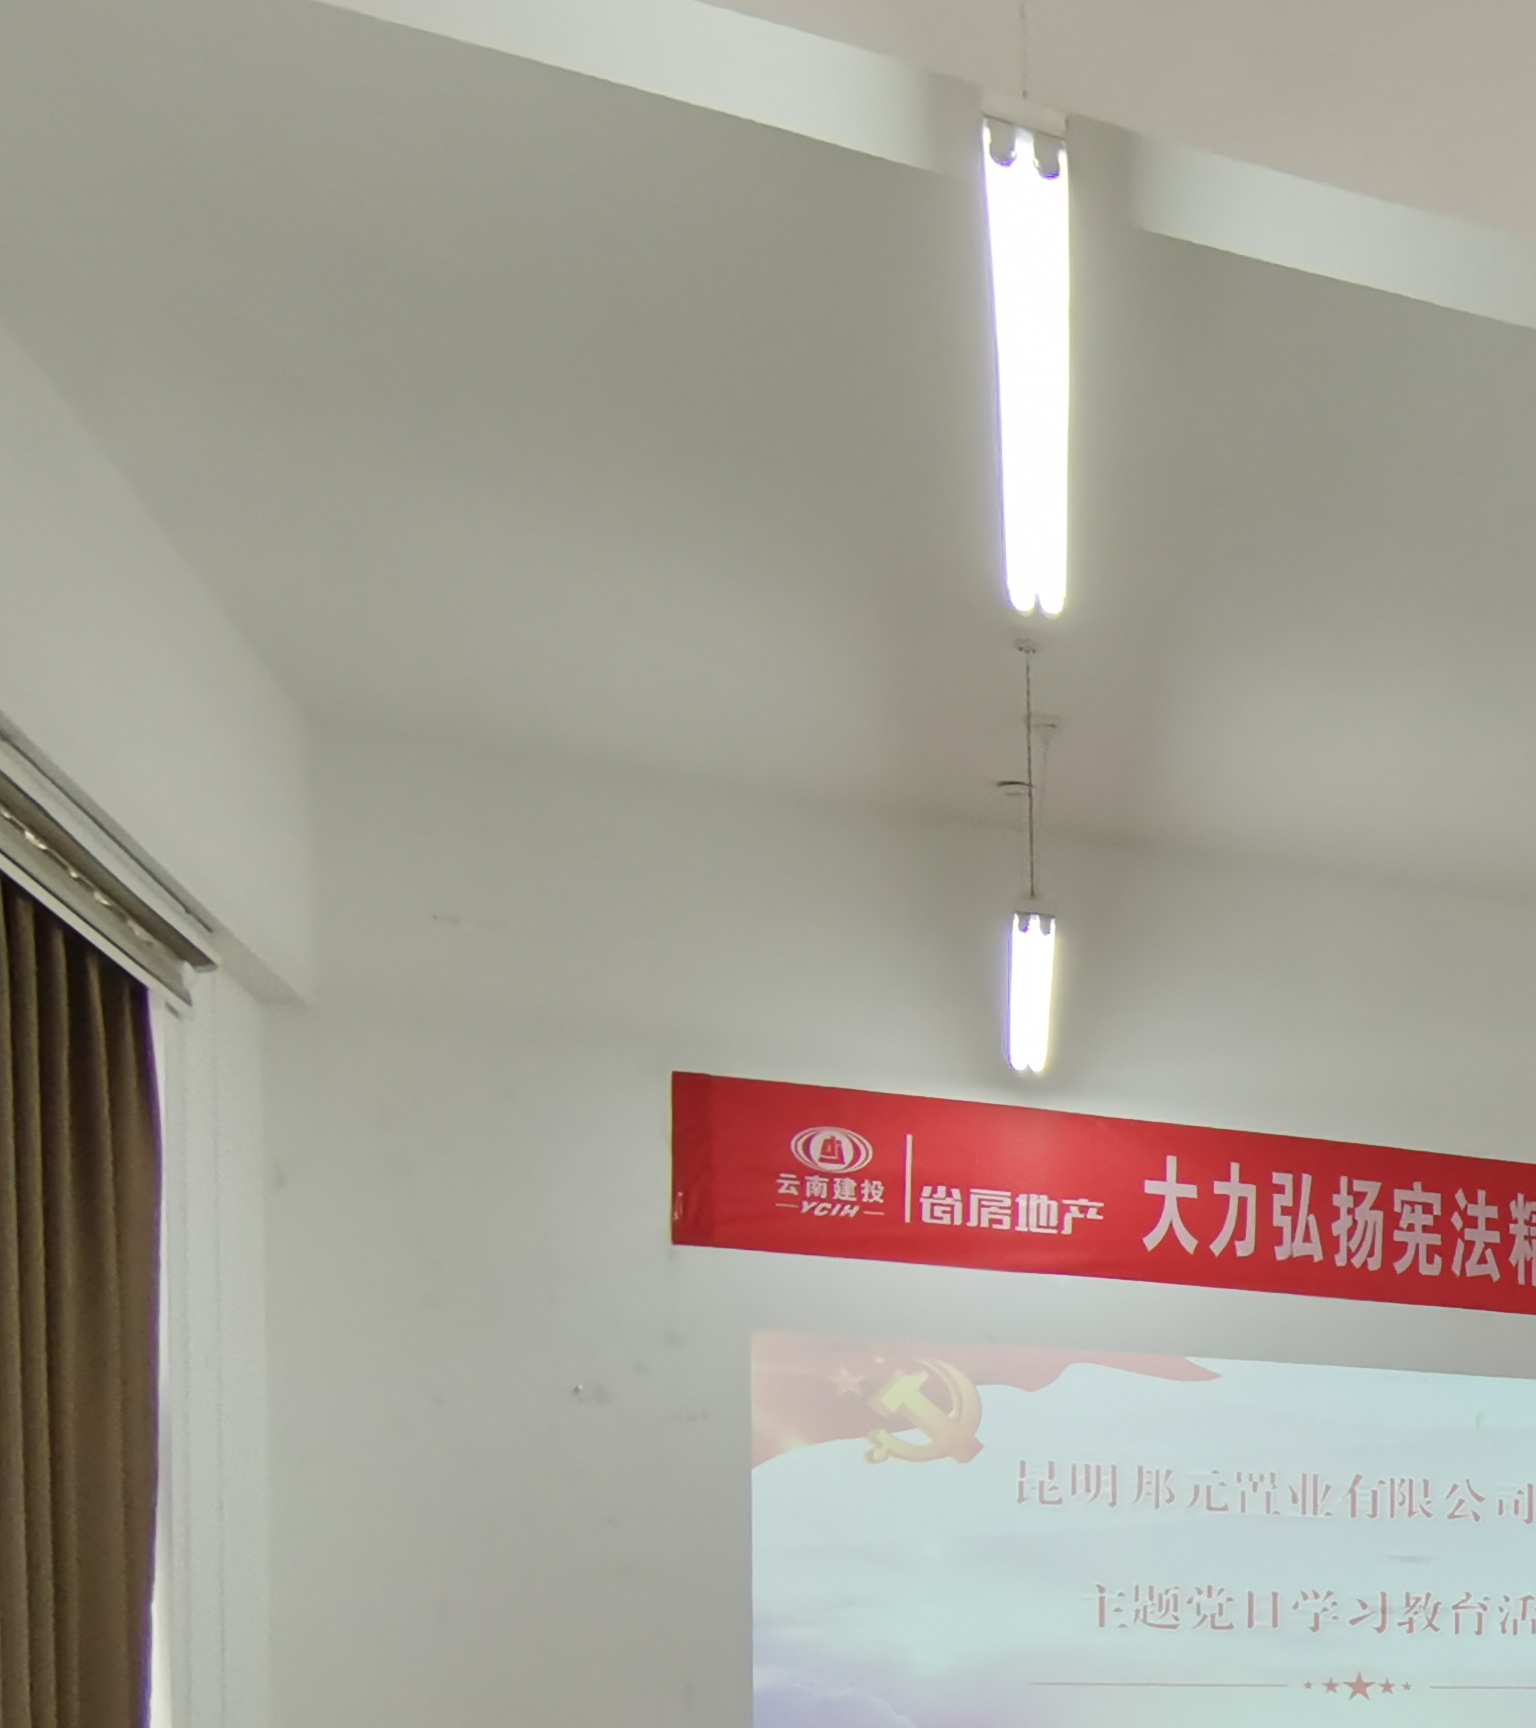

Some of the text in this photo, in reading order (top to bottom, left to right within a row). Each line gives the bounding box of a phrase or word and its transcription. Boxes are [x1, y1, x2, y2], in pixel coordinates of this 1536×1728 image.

[775, 1172, 885, 1204] 云南建投
[799, 1200, 860, 1219] YCIH
